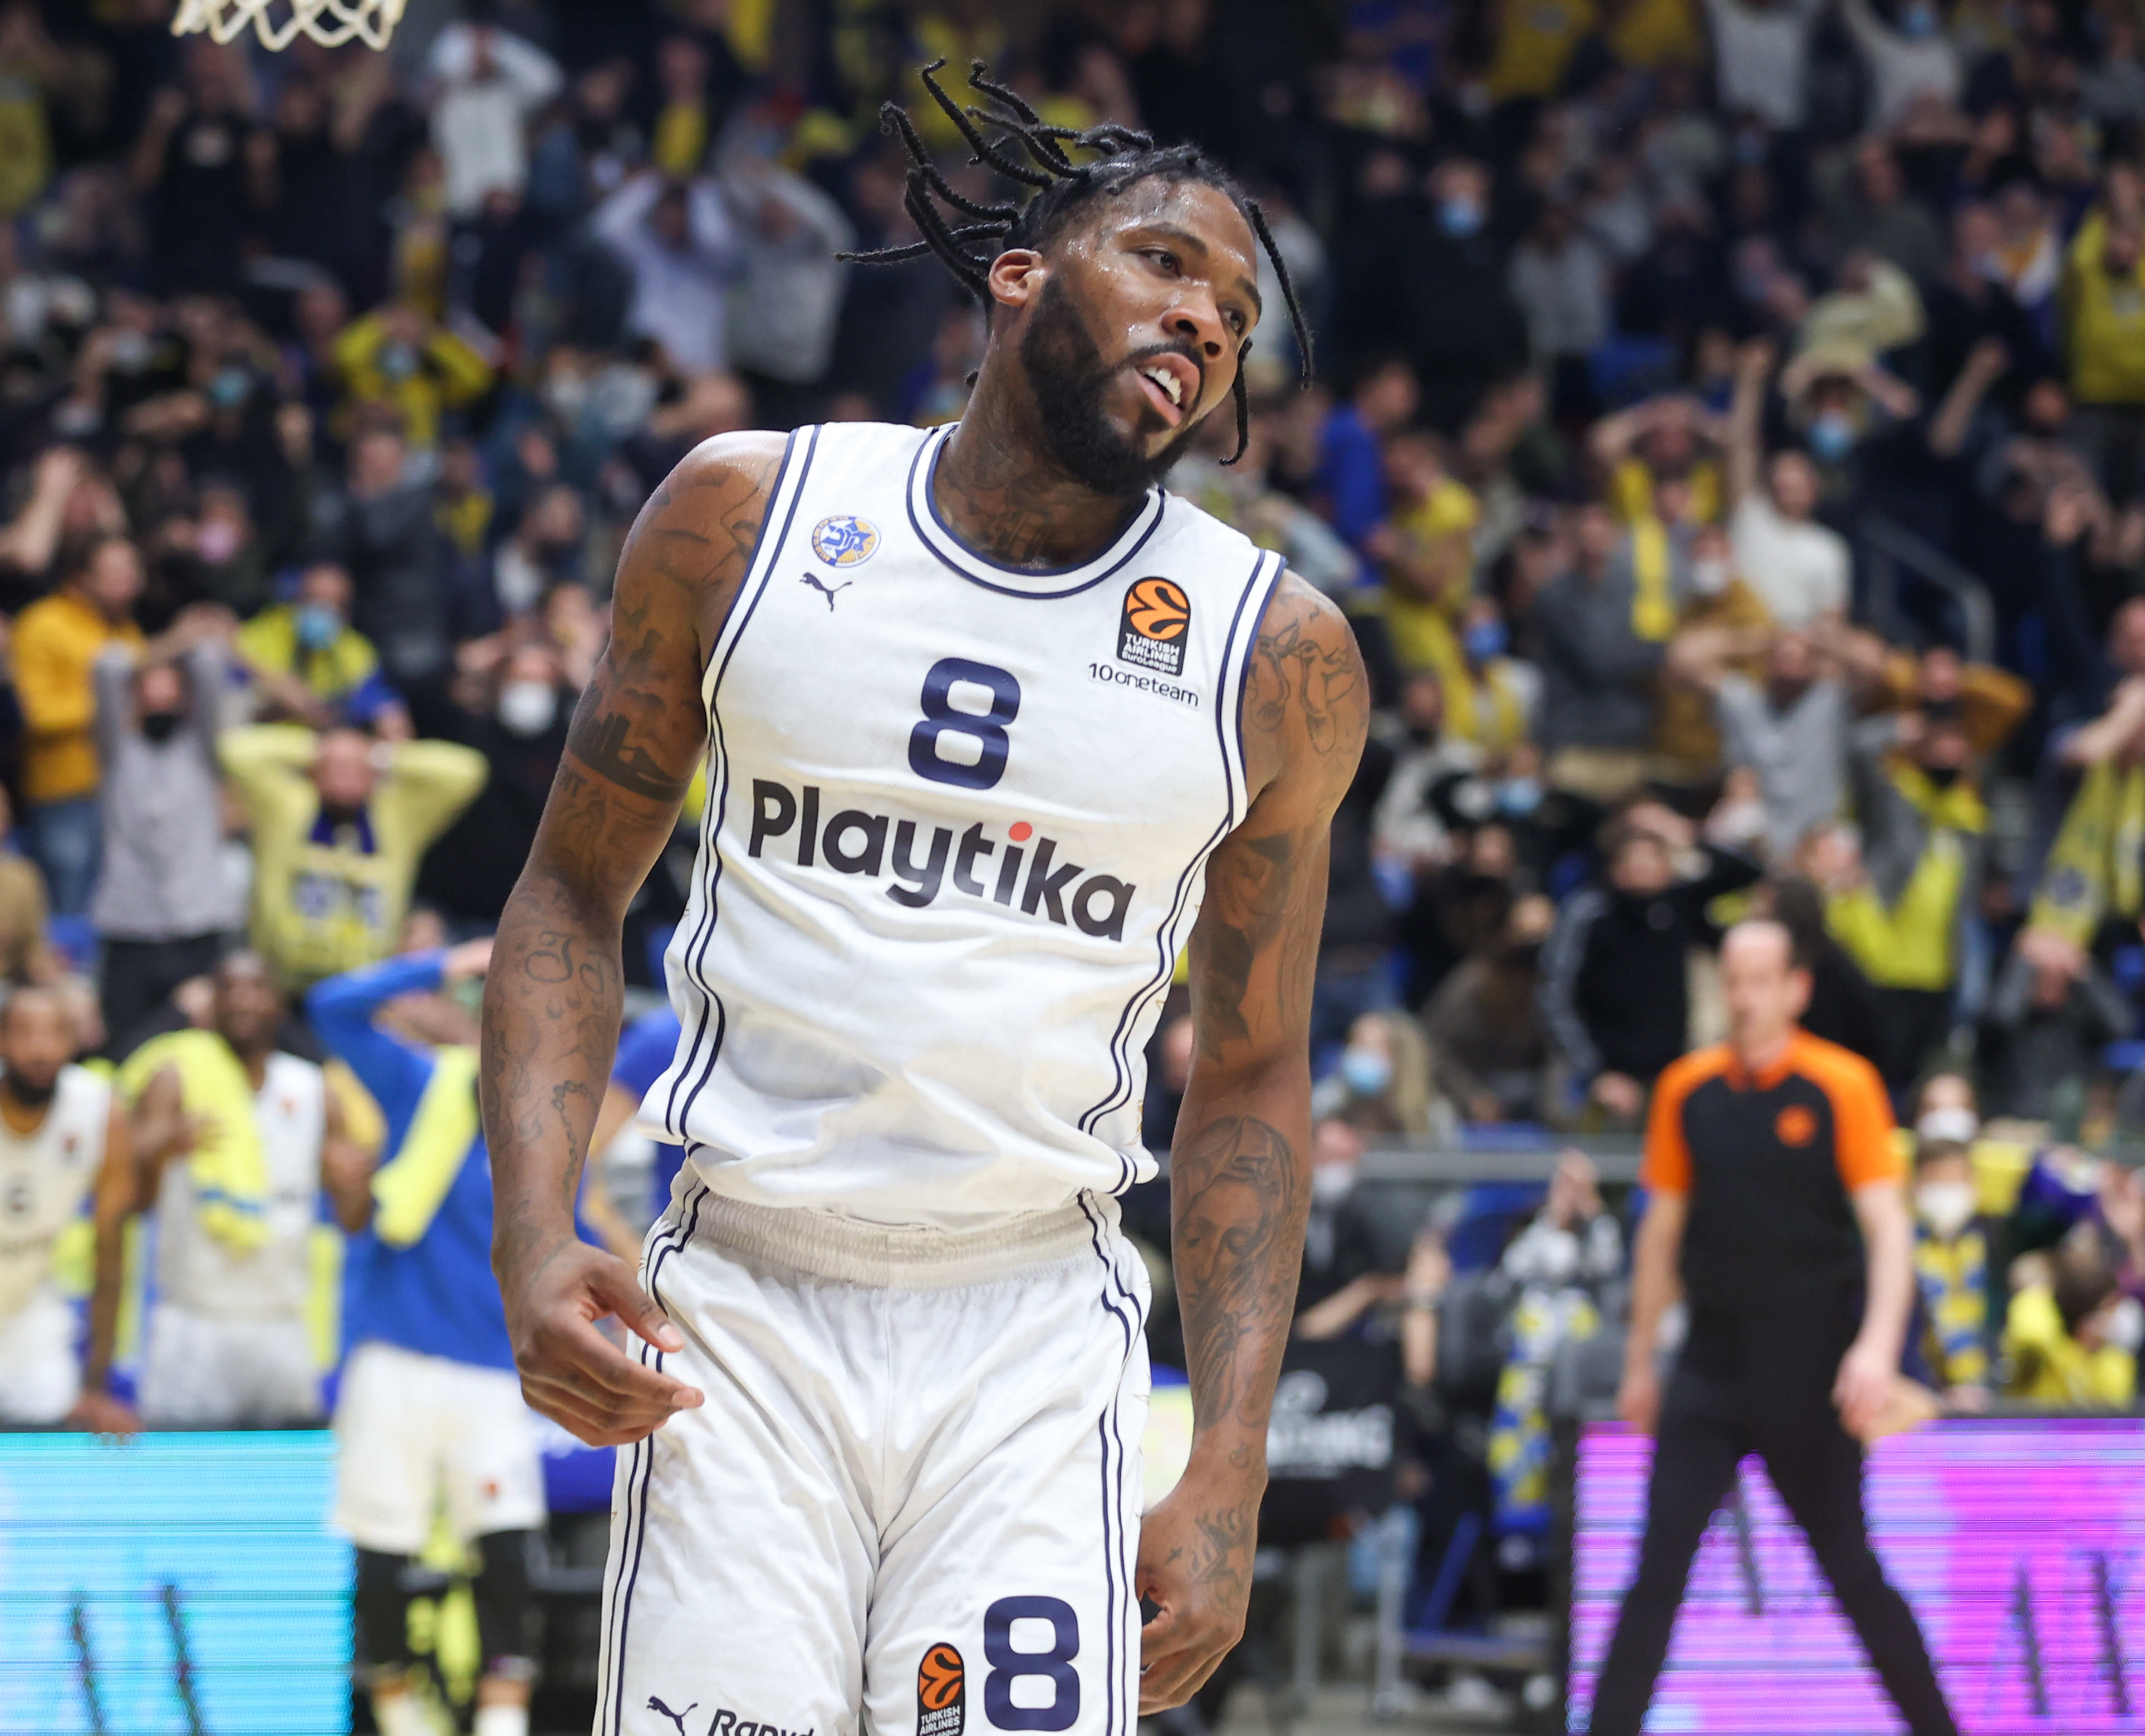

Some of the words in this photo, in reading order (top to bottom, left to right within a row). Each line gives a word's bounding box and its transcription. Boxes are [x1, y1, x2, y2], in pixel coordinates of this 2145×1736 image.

[1123, 643, 1179, 666] AIRLINES
[1125, 632, 1180, 656] TURKISH
[908, 656, 1020, 790] 8
[748, 778, 1137, 943] Playtika
[984, 1596, 1080, 1732] 8
[920, 1704, 960, 1725] TURKISH
[920, 1715, 960, 1736] AIRLINES
